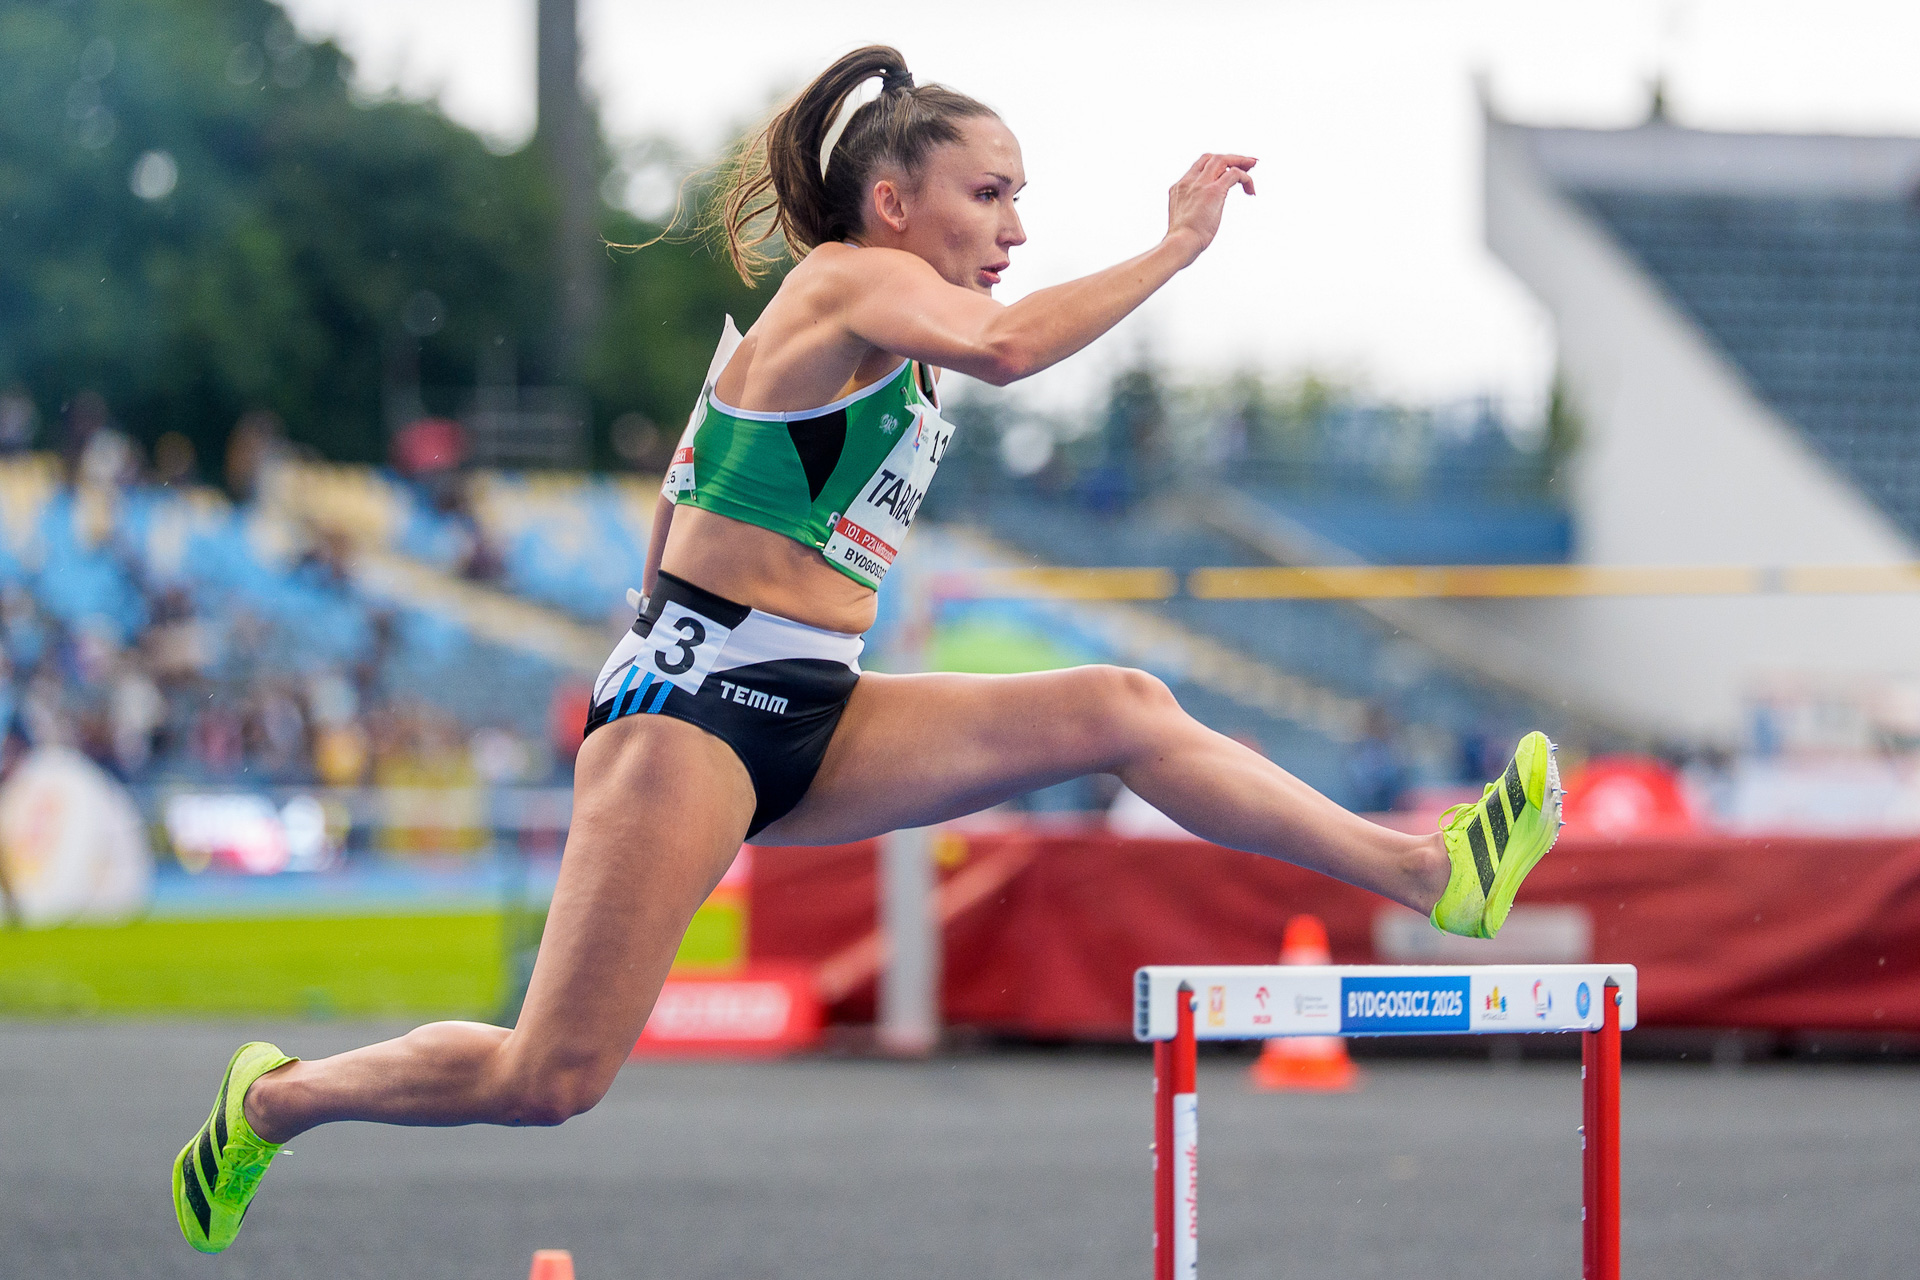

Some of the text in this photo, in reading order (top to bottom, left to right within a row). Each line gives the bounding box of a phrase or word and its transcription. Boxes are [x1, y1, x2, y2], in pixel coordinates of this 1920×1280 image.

[866, 468, 923, 528] TARAC
[844, 522, 861, 542] 101.
[654, 616, 706, 676] 3
[720, 681, 789, 715] TEMM
[1347, 990, 1430, 1018] BYDGOSZCZ
[1430, 989, 1463, 1017] 2025
